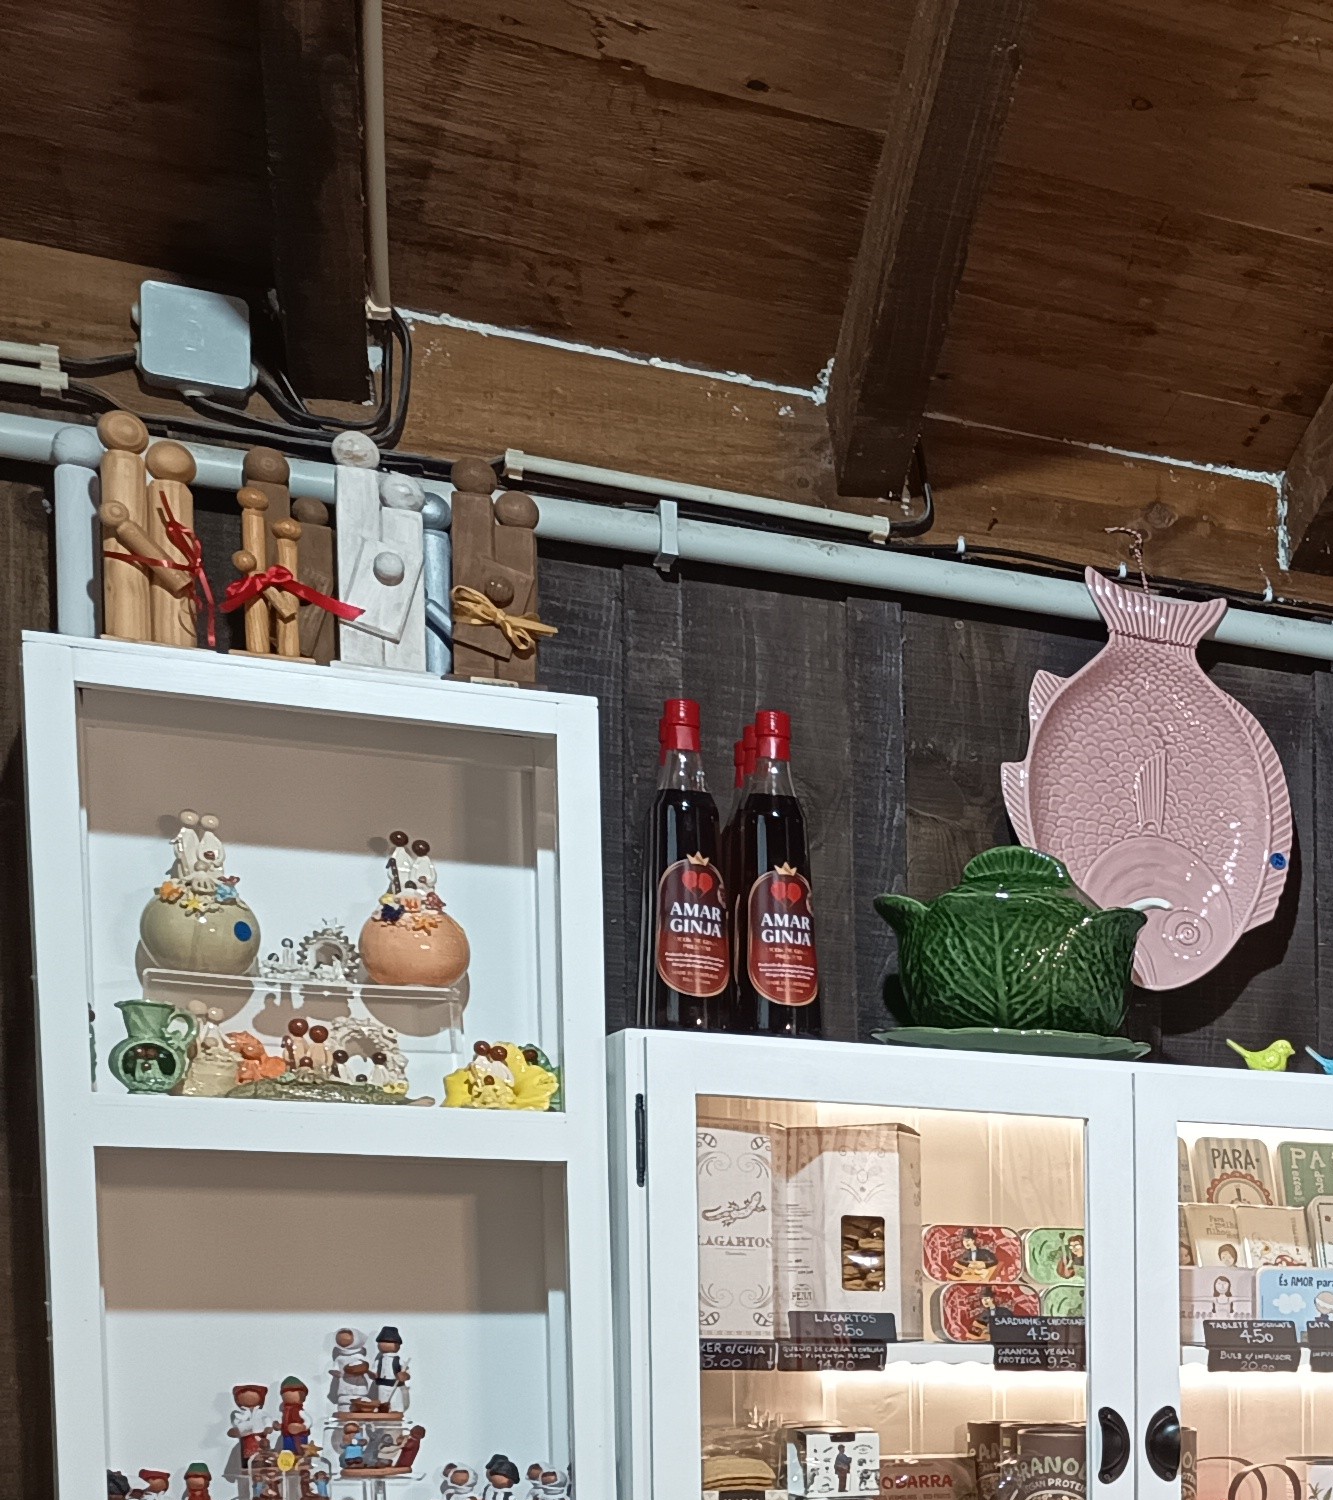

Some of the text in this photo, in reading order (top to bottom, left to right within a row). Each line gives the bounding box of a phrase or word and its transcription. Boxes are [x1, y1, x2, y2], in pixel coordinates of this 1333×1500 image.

[670, 902, 721, 922] AMAR
[670, 919, 722, 938] GINJA
[761, 913, 811, 931] AMAR
[761, 929, 812, 947] GINJA
[1291, 1277, 1314, 1287] AMOR
[814, 1314, 877, 1324] LAGARTOS
[833, 1323, 864, 1336] 9.50
[1026, 1327, 1060, 1341] 4.50
[1047, 1356, 1077, 1369] 9.50
